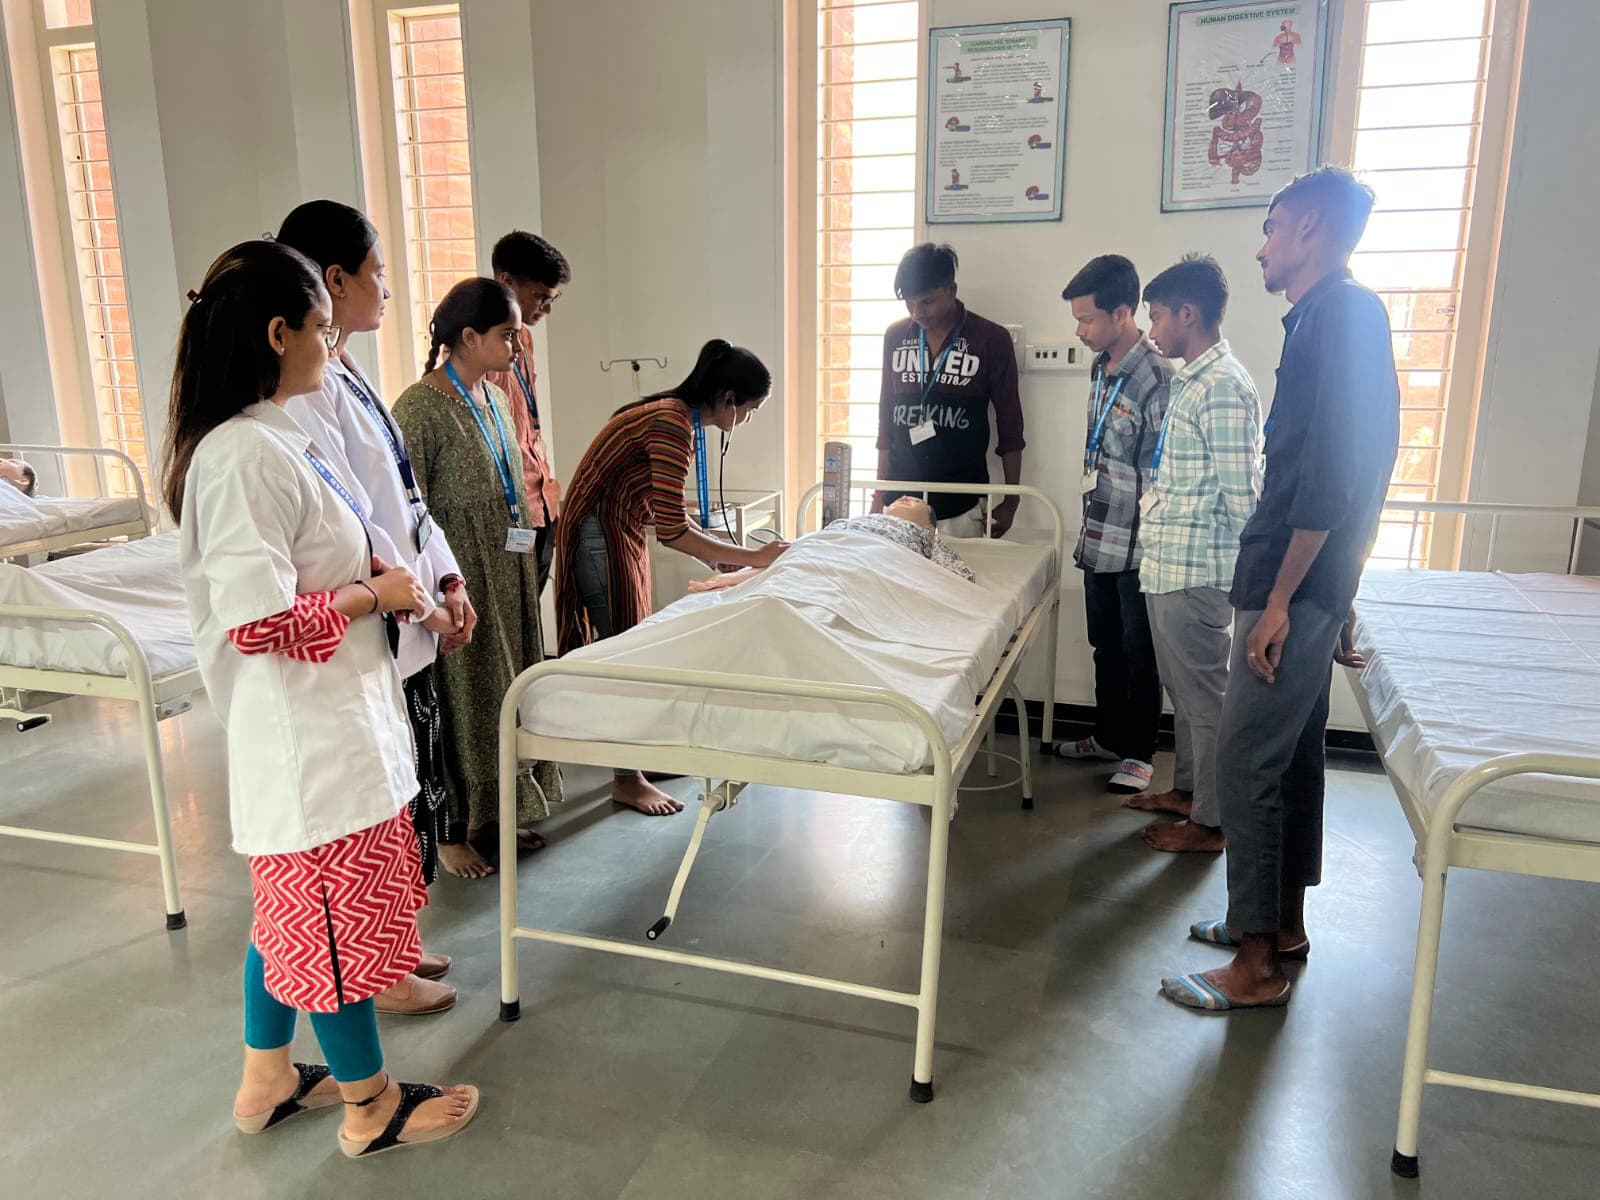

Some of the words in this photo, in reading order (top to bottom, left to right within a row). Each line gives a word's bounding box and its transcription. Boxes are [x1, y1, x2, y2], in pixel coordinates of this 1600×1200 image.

[1201, 16, 1226, 25] HUMAN
[1227, 11, 1264, 22] DIGESTIVE
[1266, 7, 1295, 17] SYSTEM
